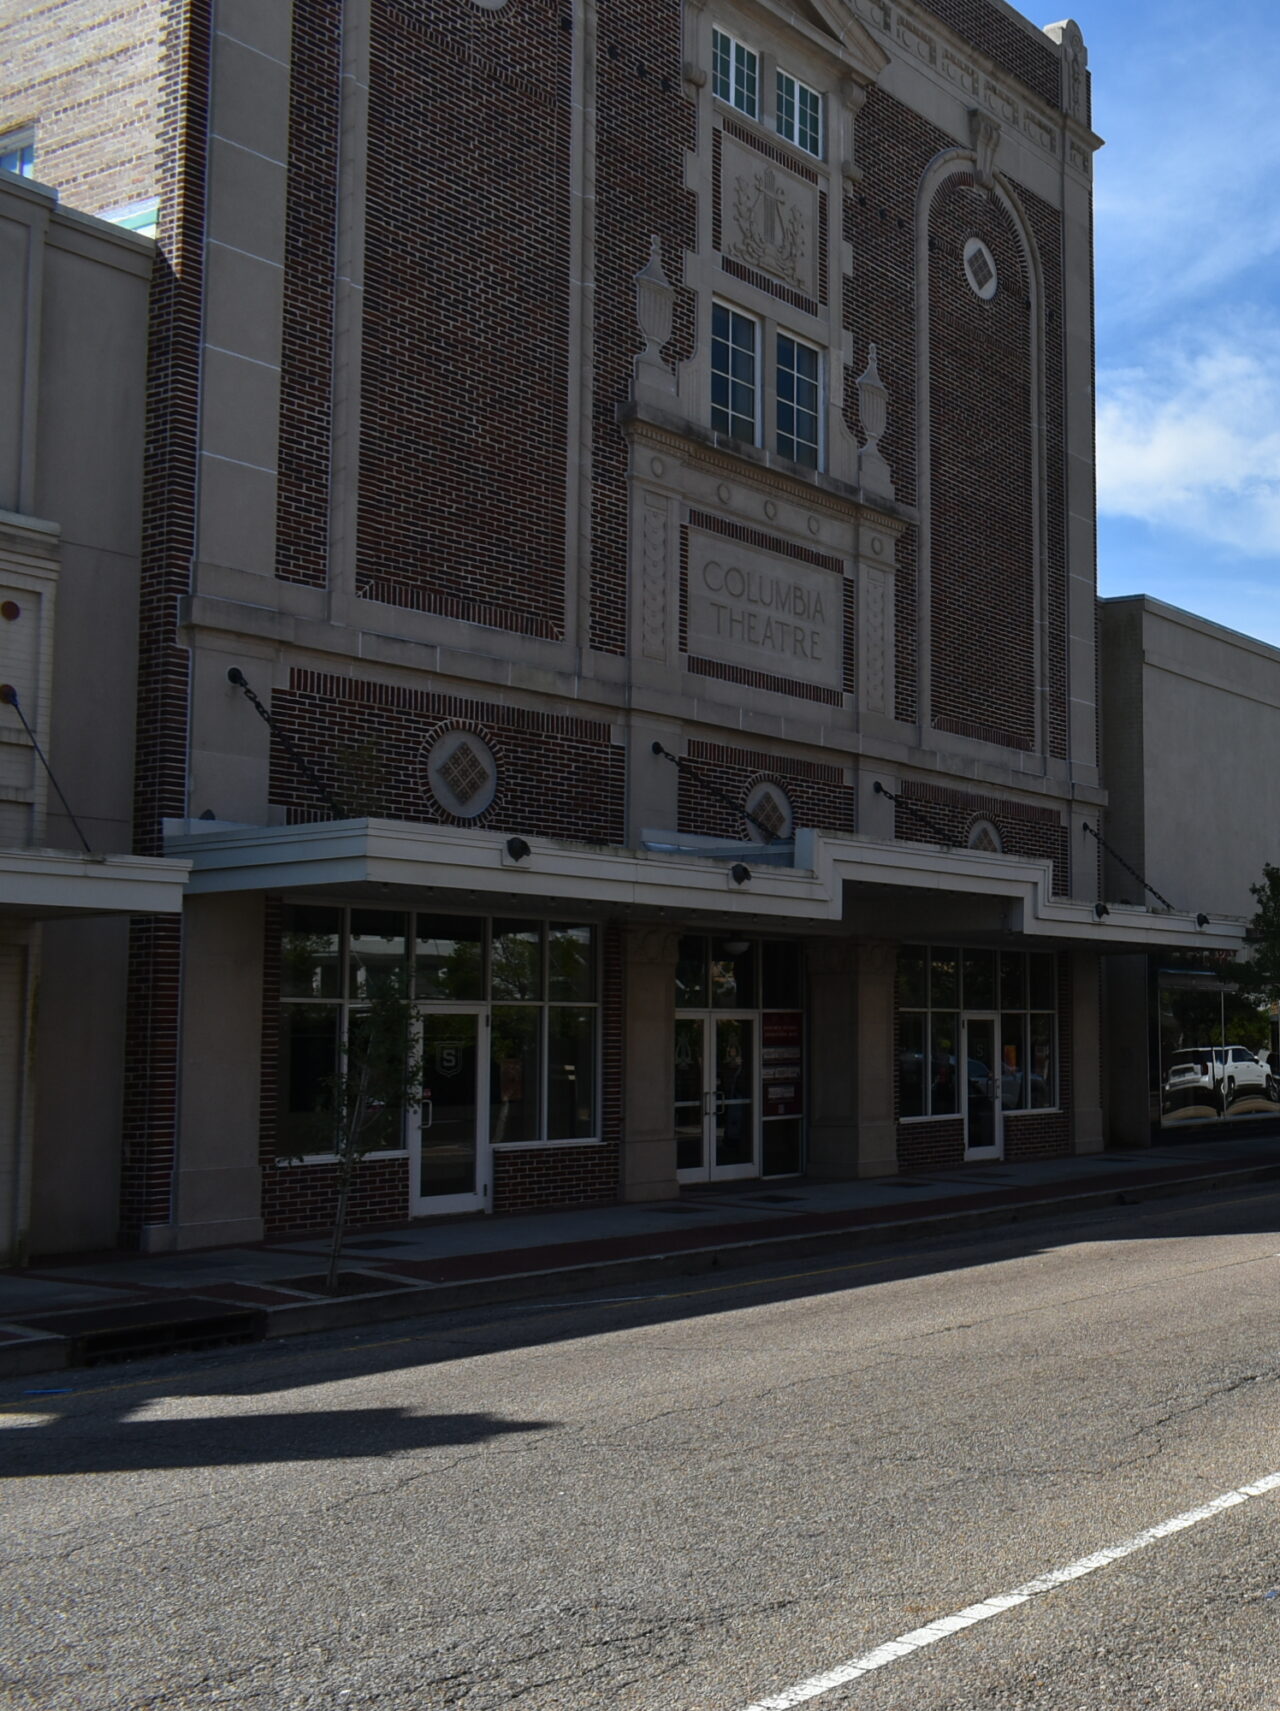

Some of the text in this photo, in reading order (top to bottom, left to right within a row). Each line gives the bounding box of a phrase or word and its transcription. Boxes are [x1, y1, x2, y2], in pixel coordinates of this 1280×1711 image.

[703, 560, 825, 624] COLUMBIA
[709, 602, 823, 661] THEATRE
[443, 1049, 456, 1067] S
